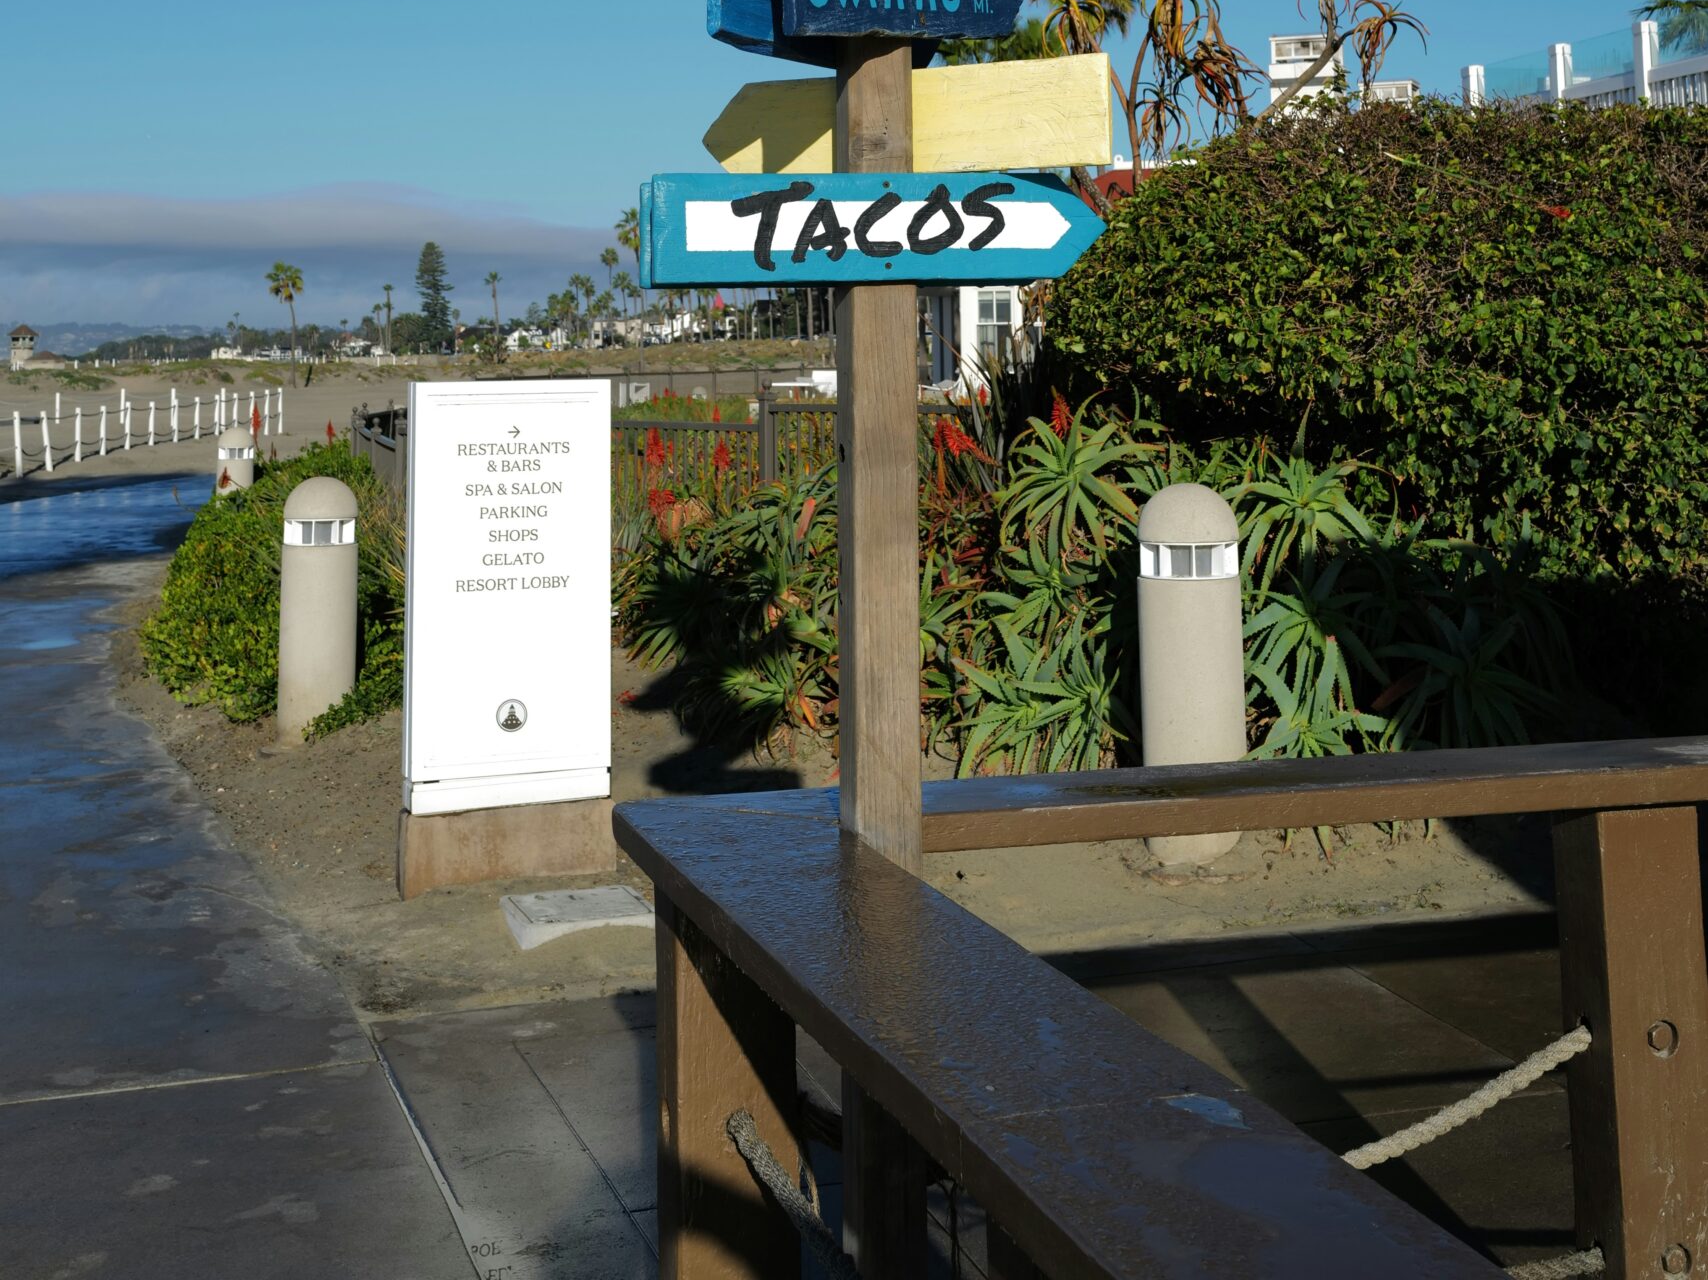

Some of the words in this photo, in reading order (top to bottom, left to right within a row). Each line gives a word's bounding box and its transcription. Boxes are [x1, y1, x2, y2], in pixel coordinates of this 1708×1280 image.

[731, 180, 1015, 271] TACOS
[457, 441, 570, 456] RESTAURANTS
[486, 459, 497, 472] &
[501, 459, 541, 472] BARS
[465, 483, 493, 496] SPA
[497, 483, 507, 495] &
[511, 481, 562, 495] SALON
[480, 505, 548, 519] PARKING
[488, 528, 539, 542] SHOPS
[482, 552, 545, 566] GELATO
[455, 578, 518, 592] RESORT
[521, 575, 570, 589] LOBBY
